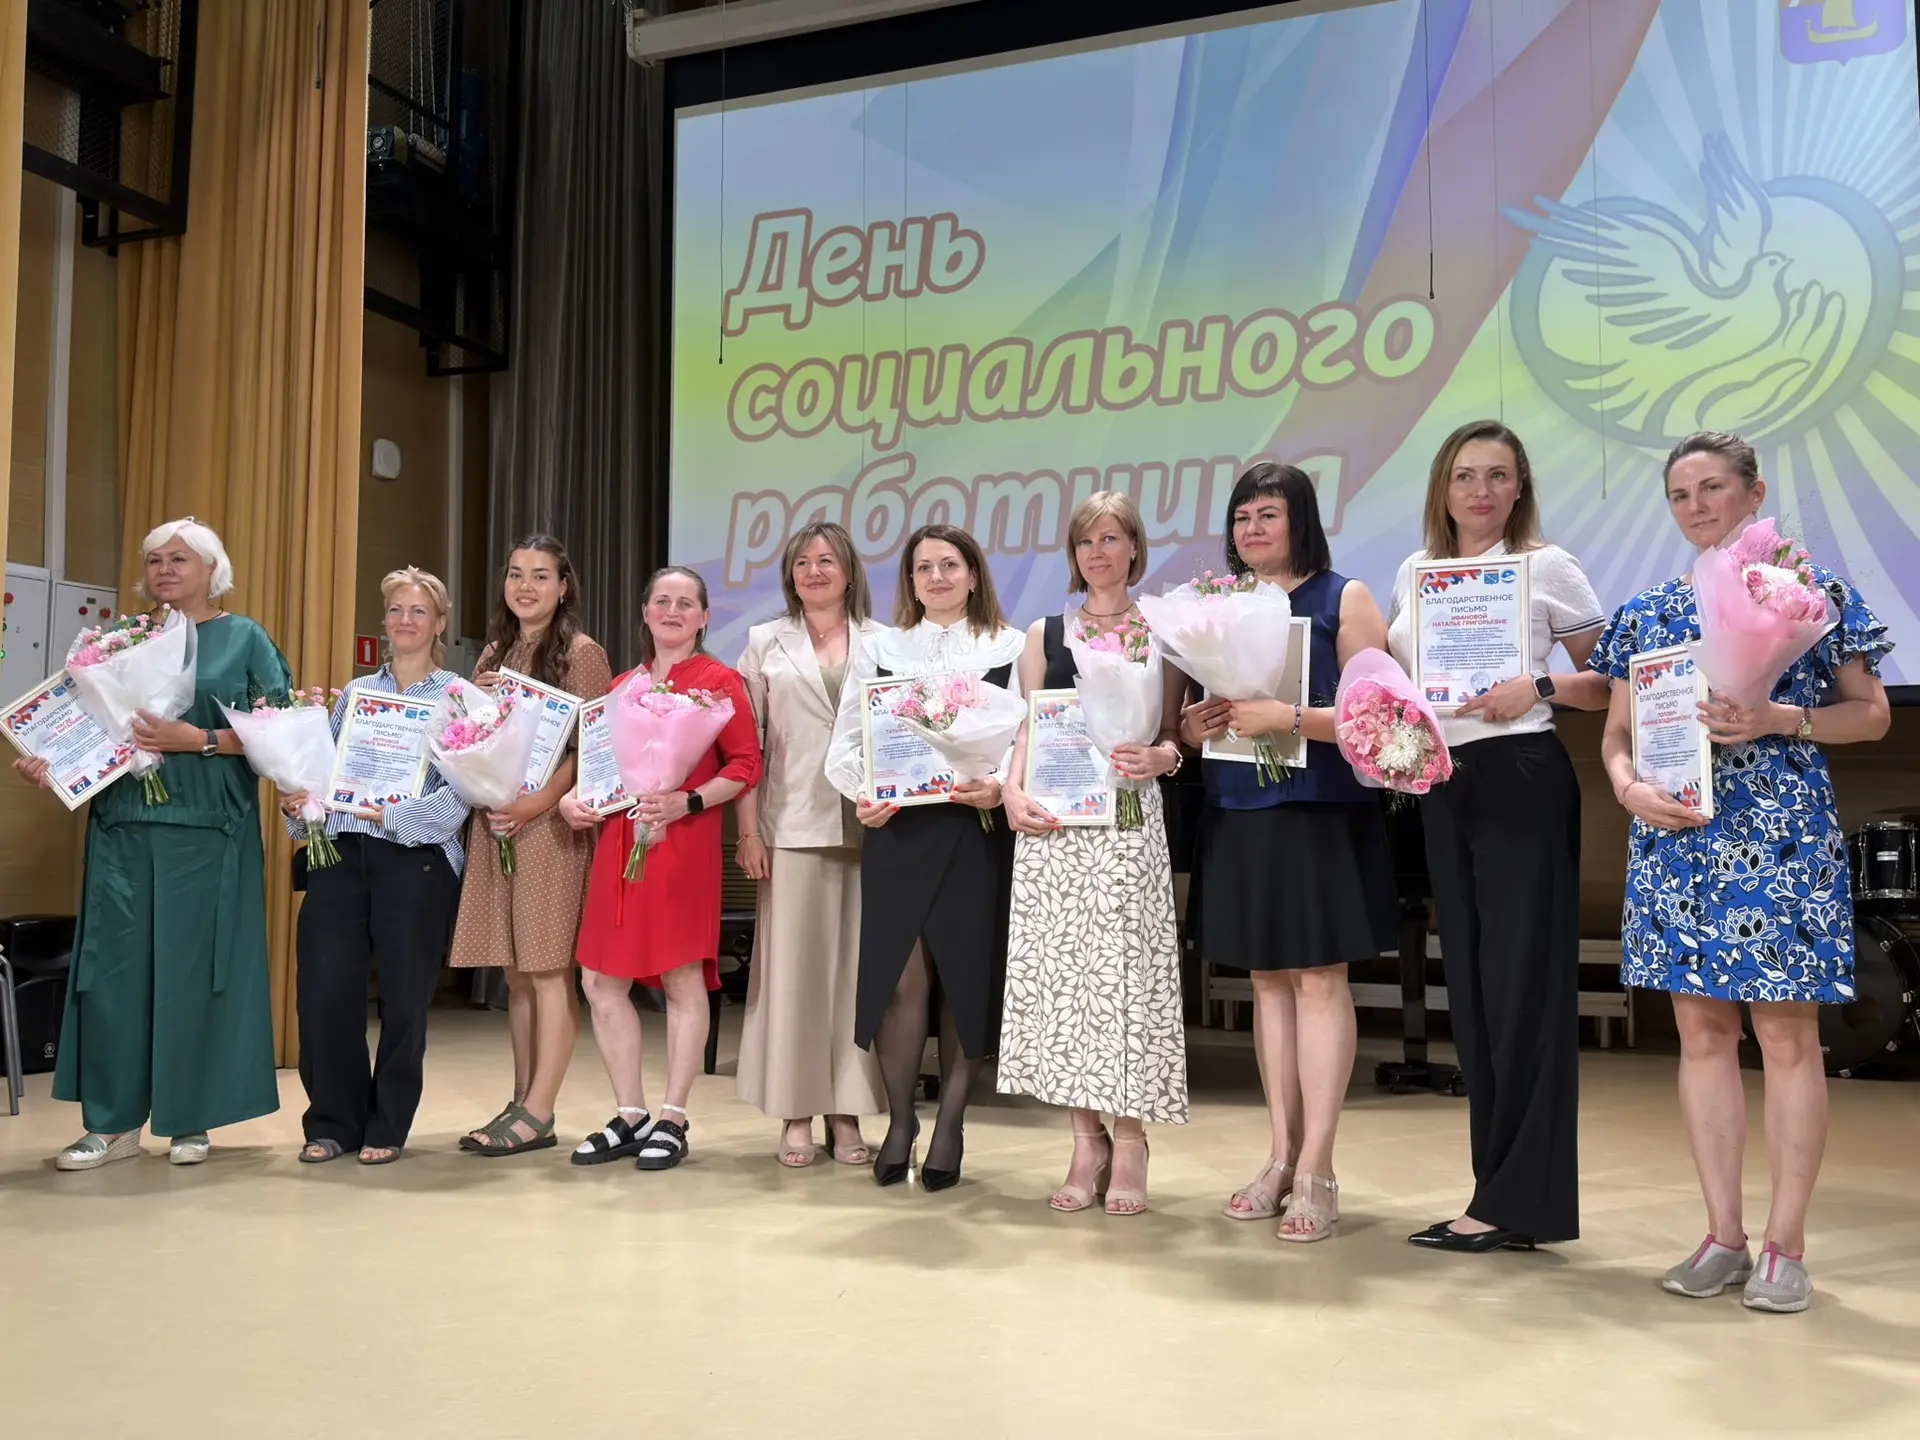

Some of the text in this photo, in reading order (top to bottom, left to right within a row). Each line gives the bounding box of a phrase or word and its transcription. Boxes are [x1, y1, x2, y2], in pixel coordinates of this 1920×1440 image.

[722, 207, 986, 336] День
[727, 293, 1437, 450] социального
[723, 446, 1350, 589] работи
[1426, 593, 1514, 605] БЛАГОДАРСТВЕННОЕ
[1450, 605, 1487, 614] ПИСЬМО
[1451, 613, 1488, 621] ИВАНОВОЙ
[1462, 618, 1508, 626] ГРИГОРЬЕВНЕ
[1430, 691, 1444, 701] 47
[22, 694, 80, 736] БЛАГОДАРСТВЕНН
[45, 709, 73, 729] ПИСЬМО
[355, 718, 425, 735] БЛАГОДАРСТВЕННОЕ
[1038, 721, 1087, 730] БЛАГОДАРСТВ
[373, 729, 402, 739] ПИСЬМО
[77, 780, 86, 792] 47
[337, 793, 350, 802] 47
[880, 789, 892, 798] 47
